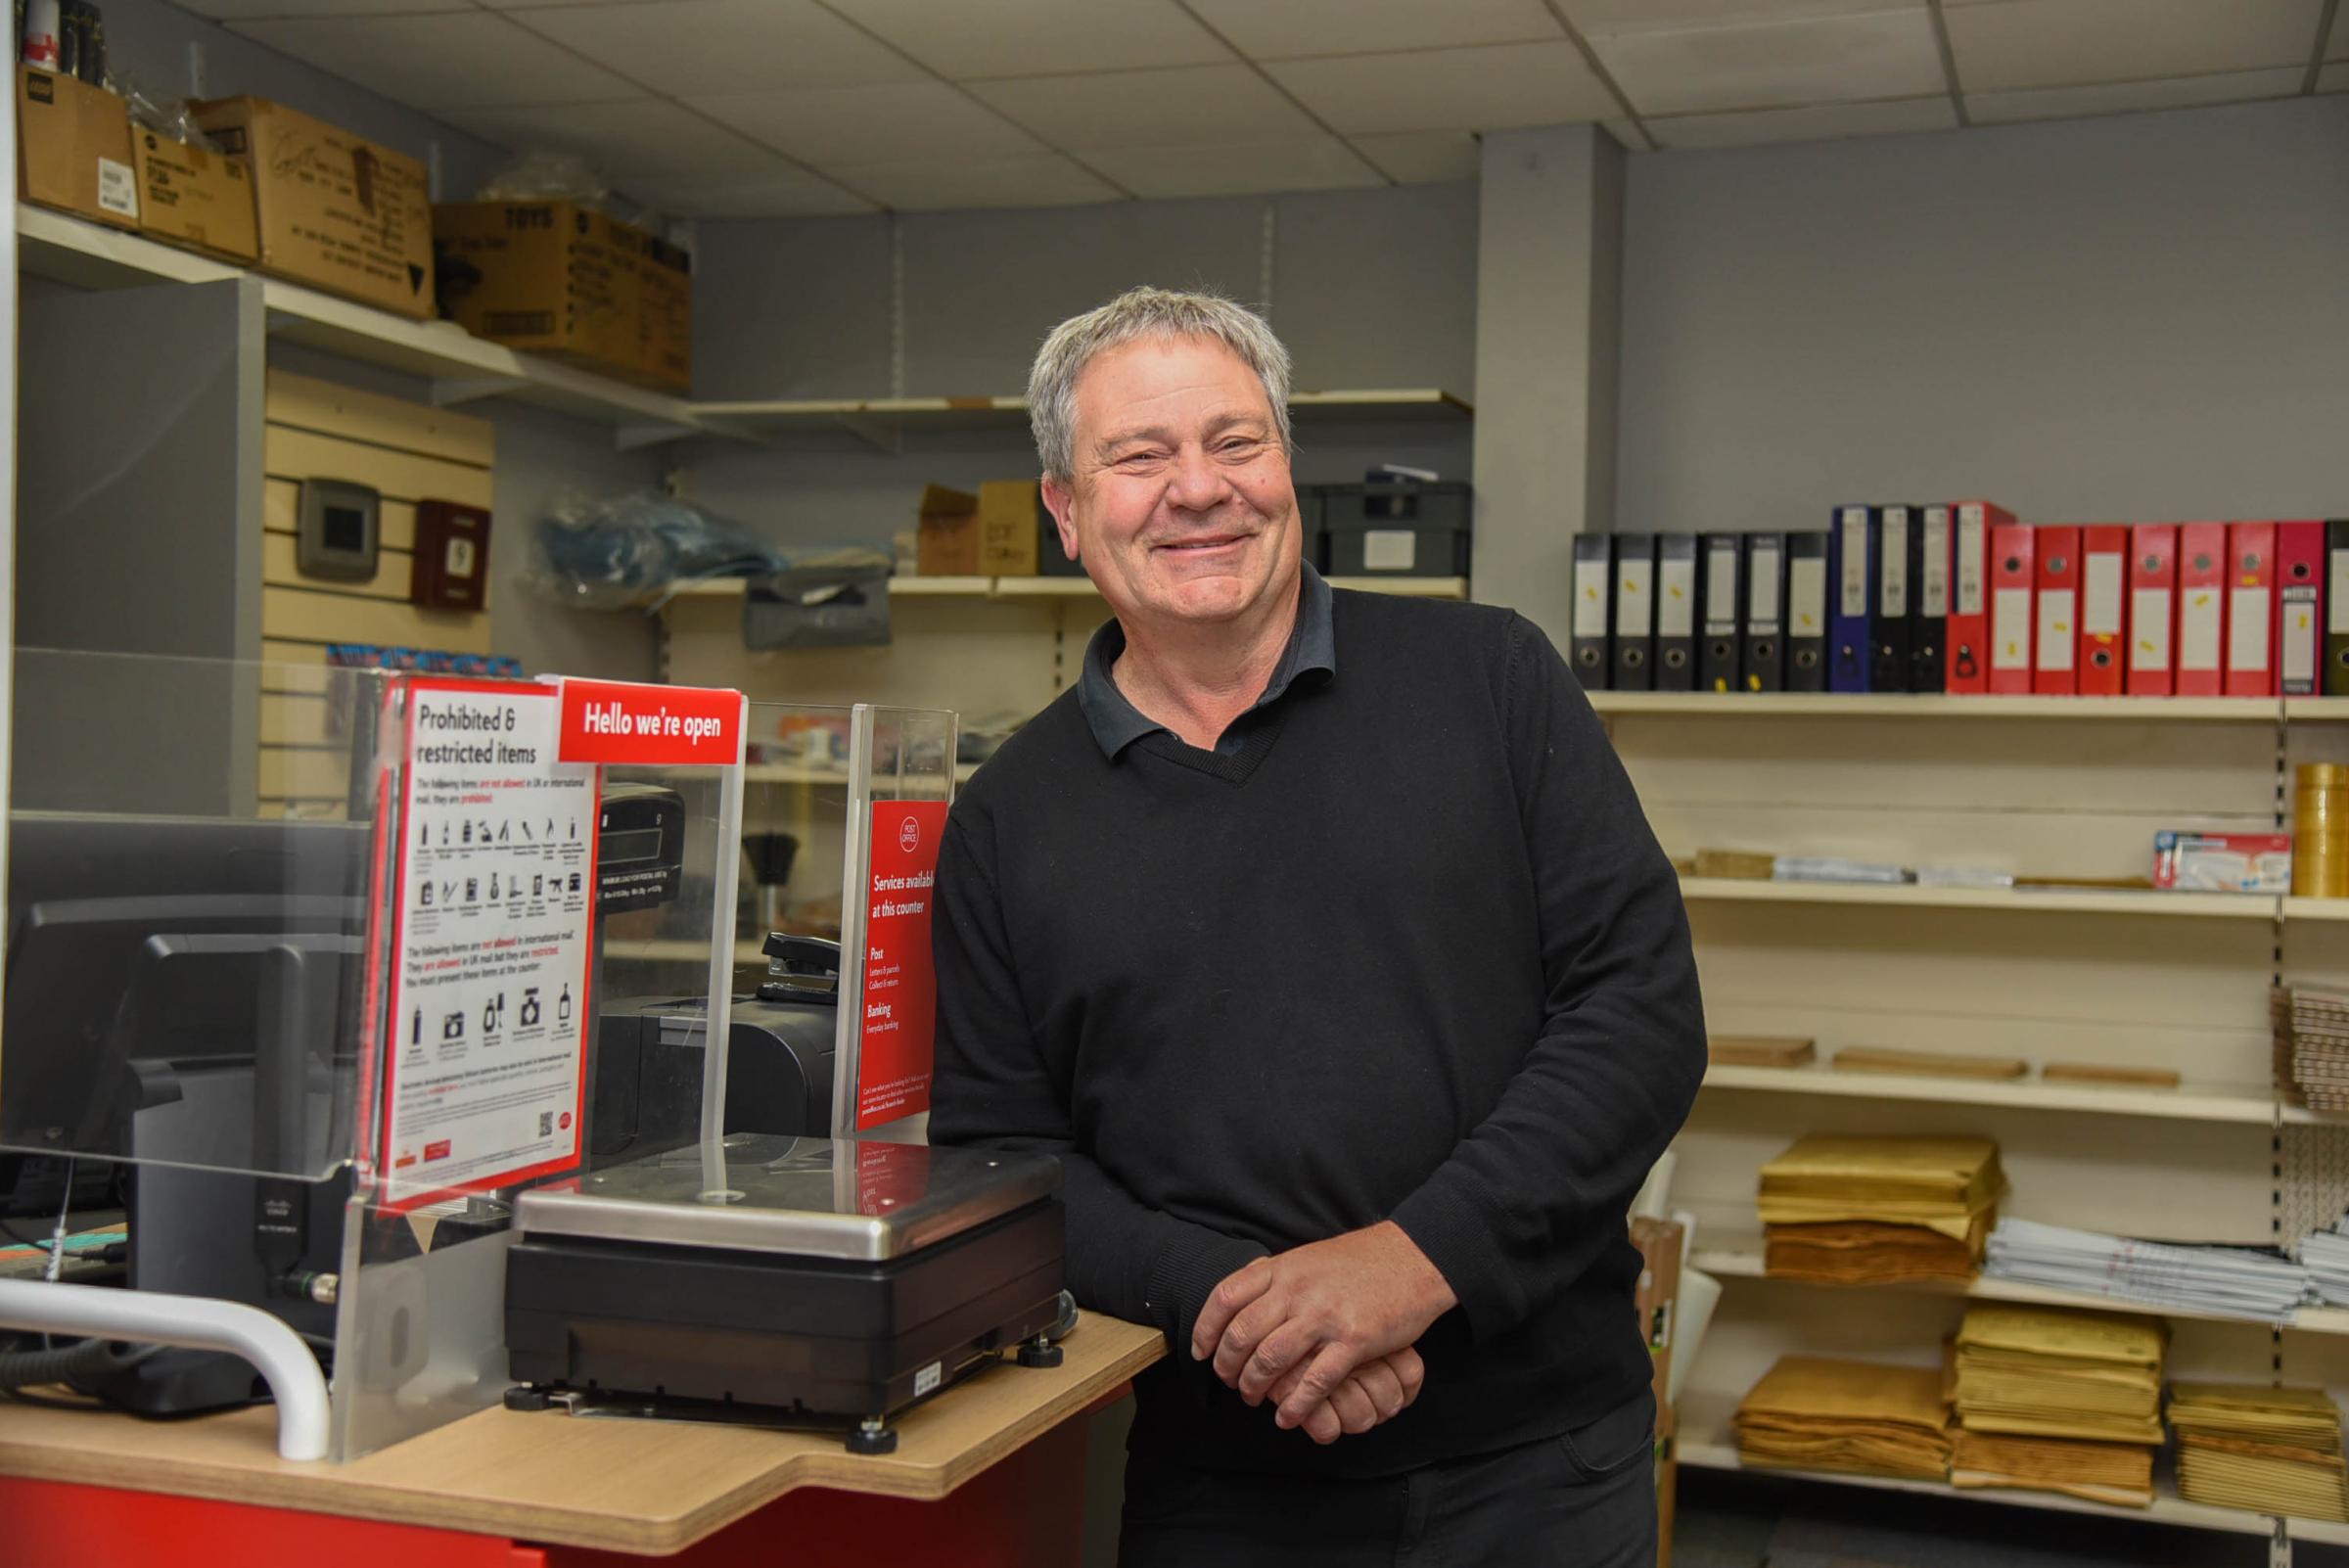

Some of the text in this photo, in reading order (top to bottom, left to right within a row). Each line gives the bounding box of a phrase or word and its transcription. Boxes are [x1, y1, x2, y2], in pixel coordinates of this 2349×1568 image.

[505, 206, 555, 230] TOYS
[419, 703, 516, 732] Prohibited &
[583, 701, 721, 746] Hello we're open
[417, 737, 536, 764] restricted items
[904, 824, 916, 833] POST
[901, 834, 916, 843] OFFICE
[874, 874, 904, 892] Services
[872, 899, 925, 918] at this counter
[408, 945, 420, 957] The
[422, 944, 450, 957] following
[525, 933, 561, 945] international
[870, 947, 884, 960] Post
[407, 961, 423, 974] They
[886, 962, 900, 976] parcels
[867, 1002, 892, 1018] Banking
[866, 1020, 898, 1035] Everyday banking
